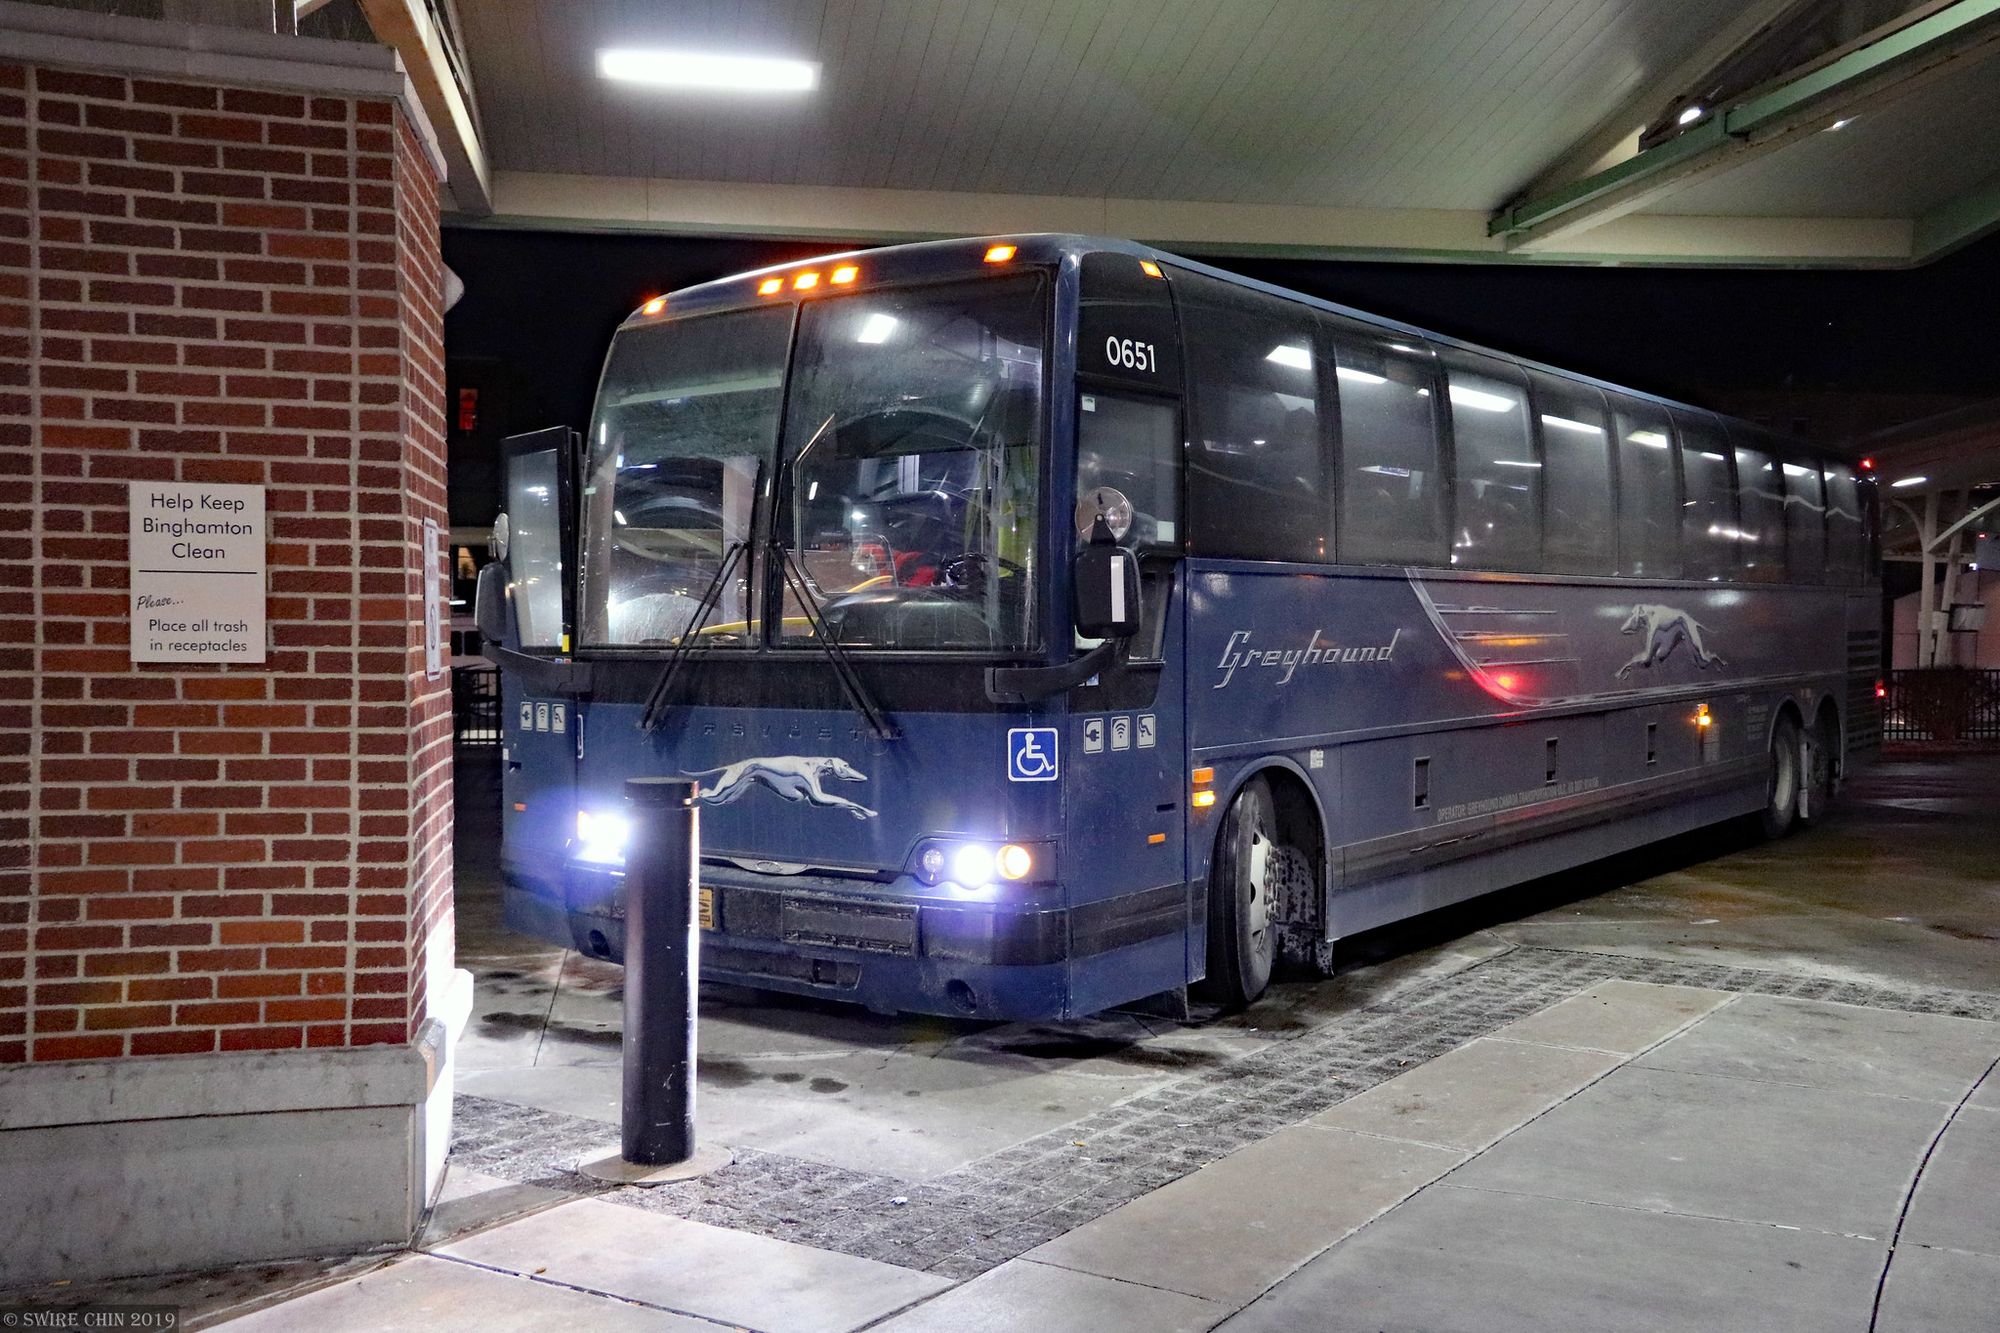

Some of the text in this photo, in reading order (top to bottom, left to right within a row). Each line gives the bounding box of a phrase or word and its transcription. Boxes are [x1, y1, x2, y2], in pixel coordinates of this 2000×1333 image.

[1106, 335, 1156, 373] 0651
[151, 493, 245, 513] Help Keep
[143, 517, 252, 537] Binghamton
[171, 542, 225, 559] Clean
[149, 619, 248, 633] Place all trash
[150, 639, 247, 653] in receptacles
[1213, 628, 1401, 689] Greyhound
